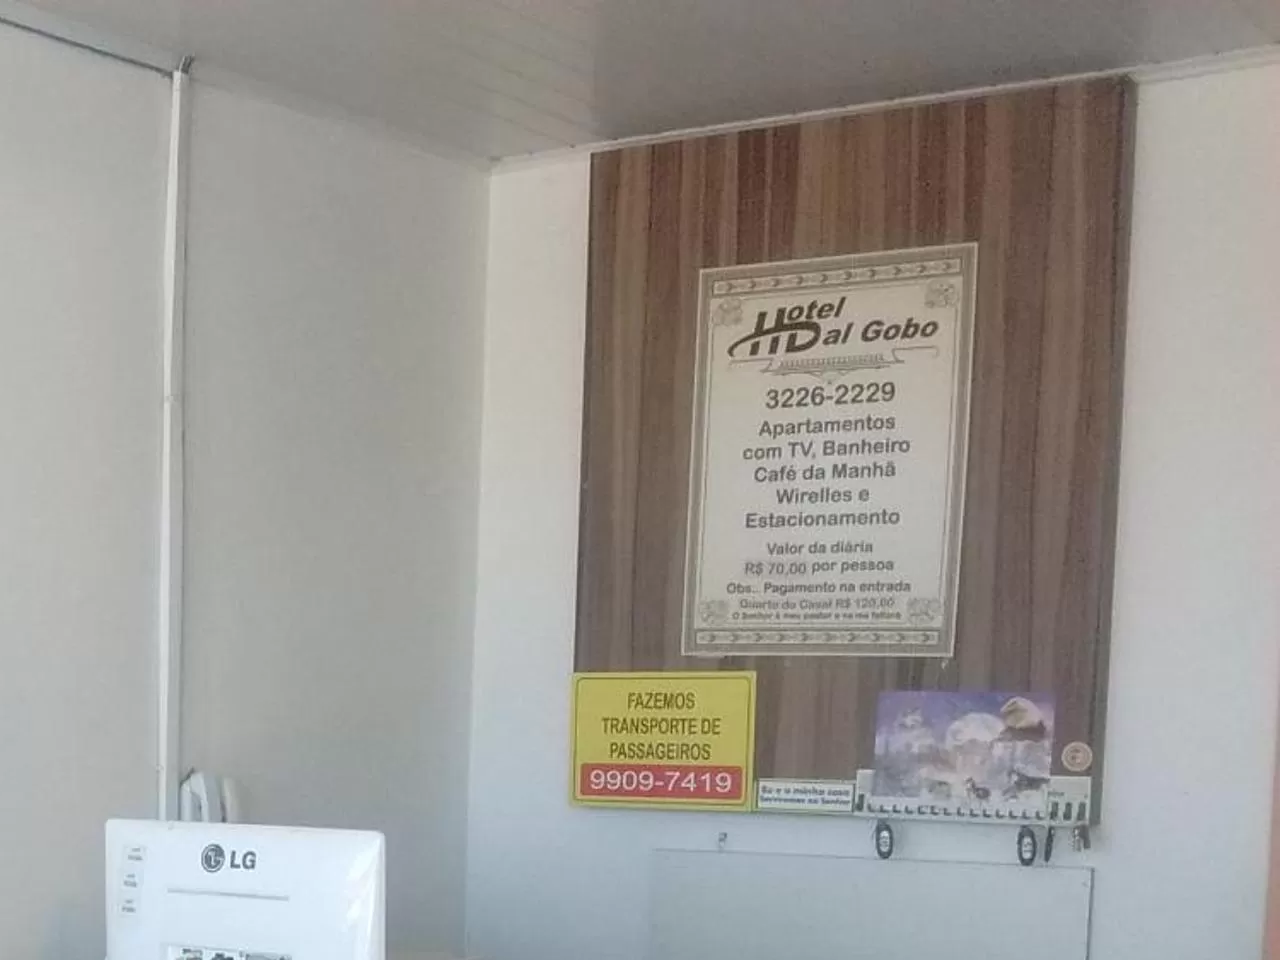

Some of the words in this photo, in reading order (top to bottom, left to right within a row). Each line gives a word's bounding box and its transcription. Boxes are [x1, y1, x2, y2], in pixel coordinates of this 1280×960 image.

[749, 297, 846, 355] Hotel
[861, 318, 938, 342] Gobo
[765, 382, 895, 409] 3226-2229
[759, 414, 896, 439] Apartamentos
[743, 446, 782, 460] com
[823, 438, 910, 456] Banheiro
[754, 465, 796, 482] Café
[803, 464, 825, 480] da
[832, 461, 896, 478] Manhã
[776, 488, 852, 503] Wirelles
[859, 489, 870, 501] e
[745, 509, 900, 528] Estacionamento
[767, 542, 804, 555] Valor
[808, 541, 826, 554] da
[745, 561, 763, 577] R$
[768, 561, 807, 576] 70,00
[811, 560, 837, 574] por
[841, 560, 894, 573] pessoa
[764, 581, 836, 596] Pagamento
[840, 581, 856, 593] na
[860, 579, 911, 593] entrada
[627, 692, 695, 709] FAZEMOS
[602, 717, 696, 735] TRANSPORTE
[701, 718, 721, 736] DE
[610, 742, 711, 761] PASSAGEIROS
[589, 769, 732, 793] 9909-7419
[230, 851, 256, 870] LG
